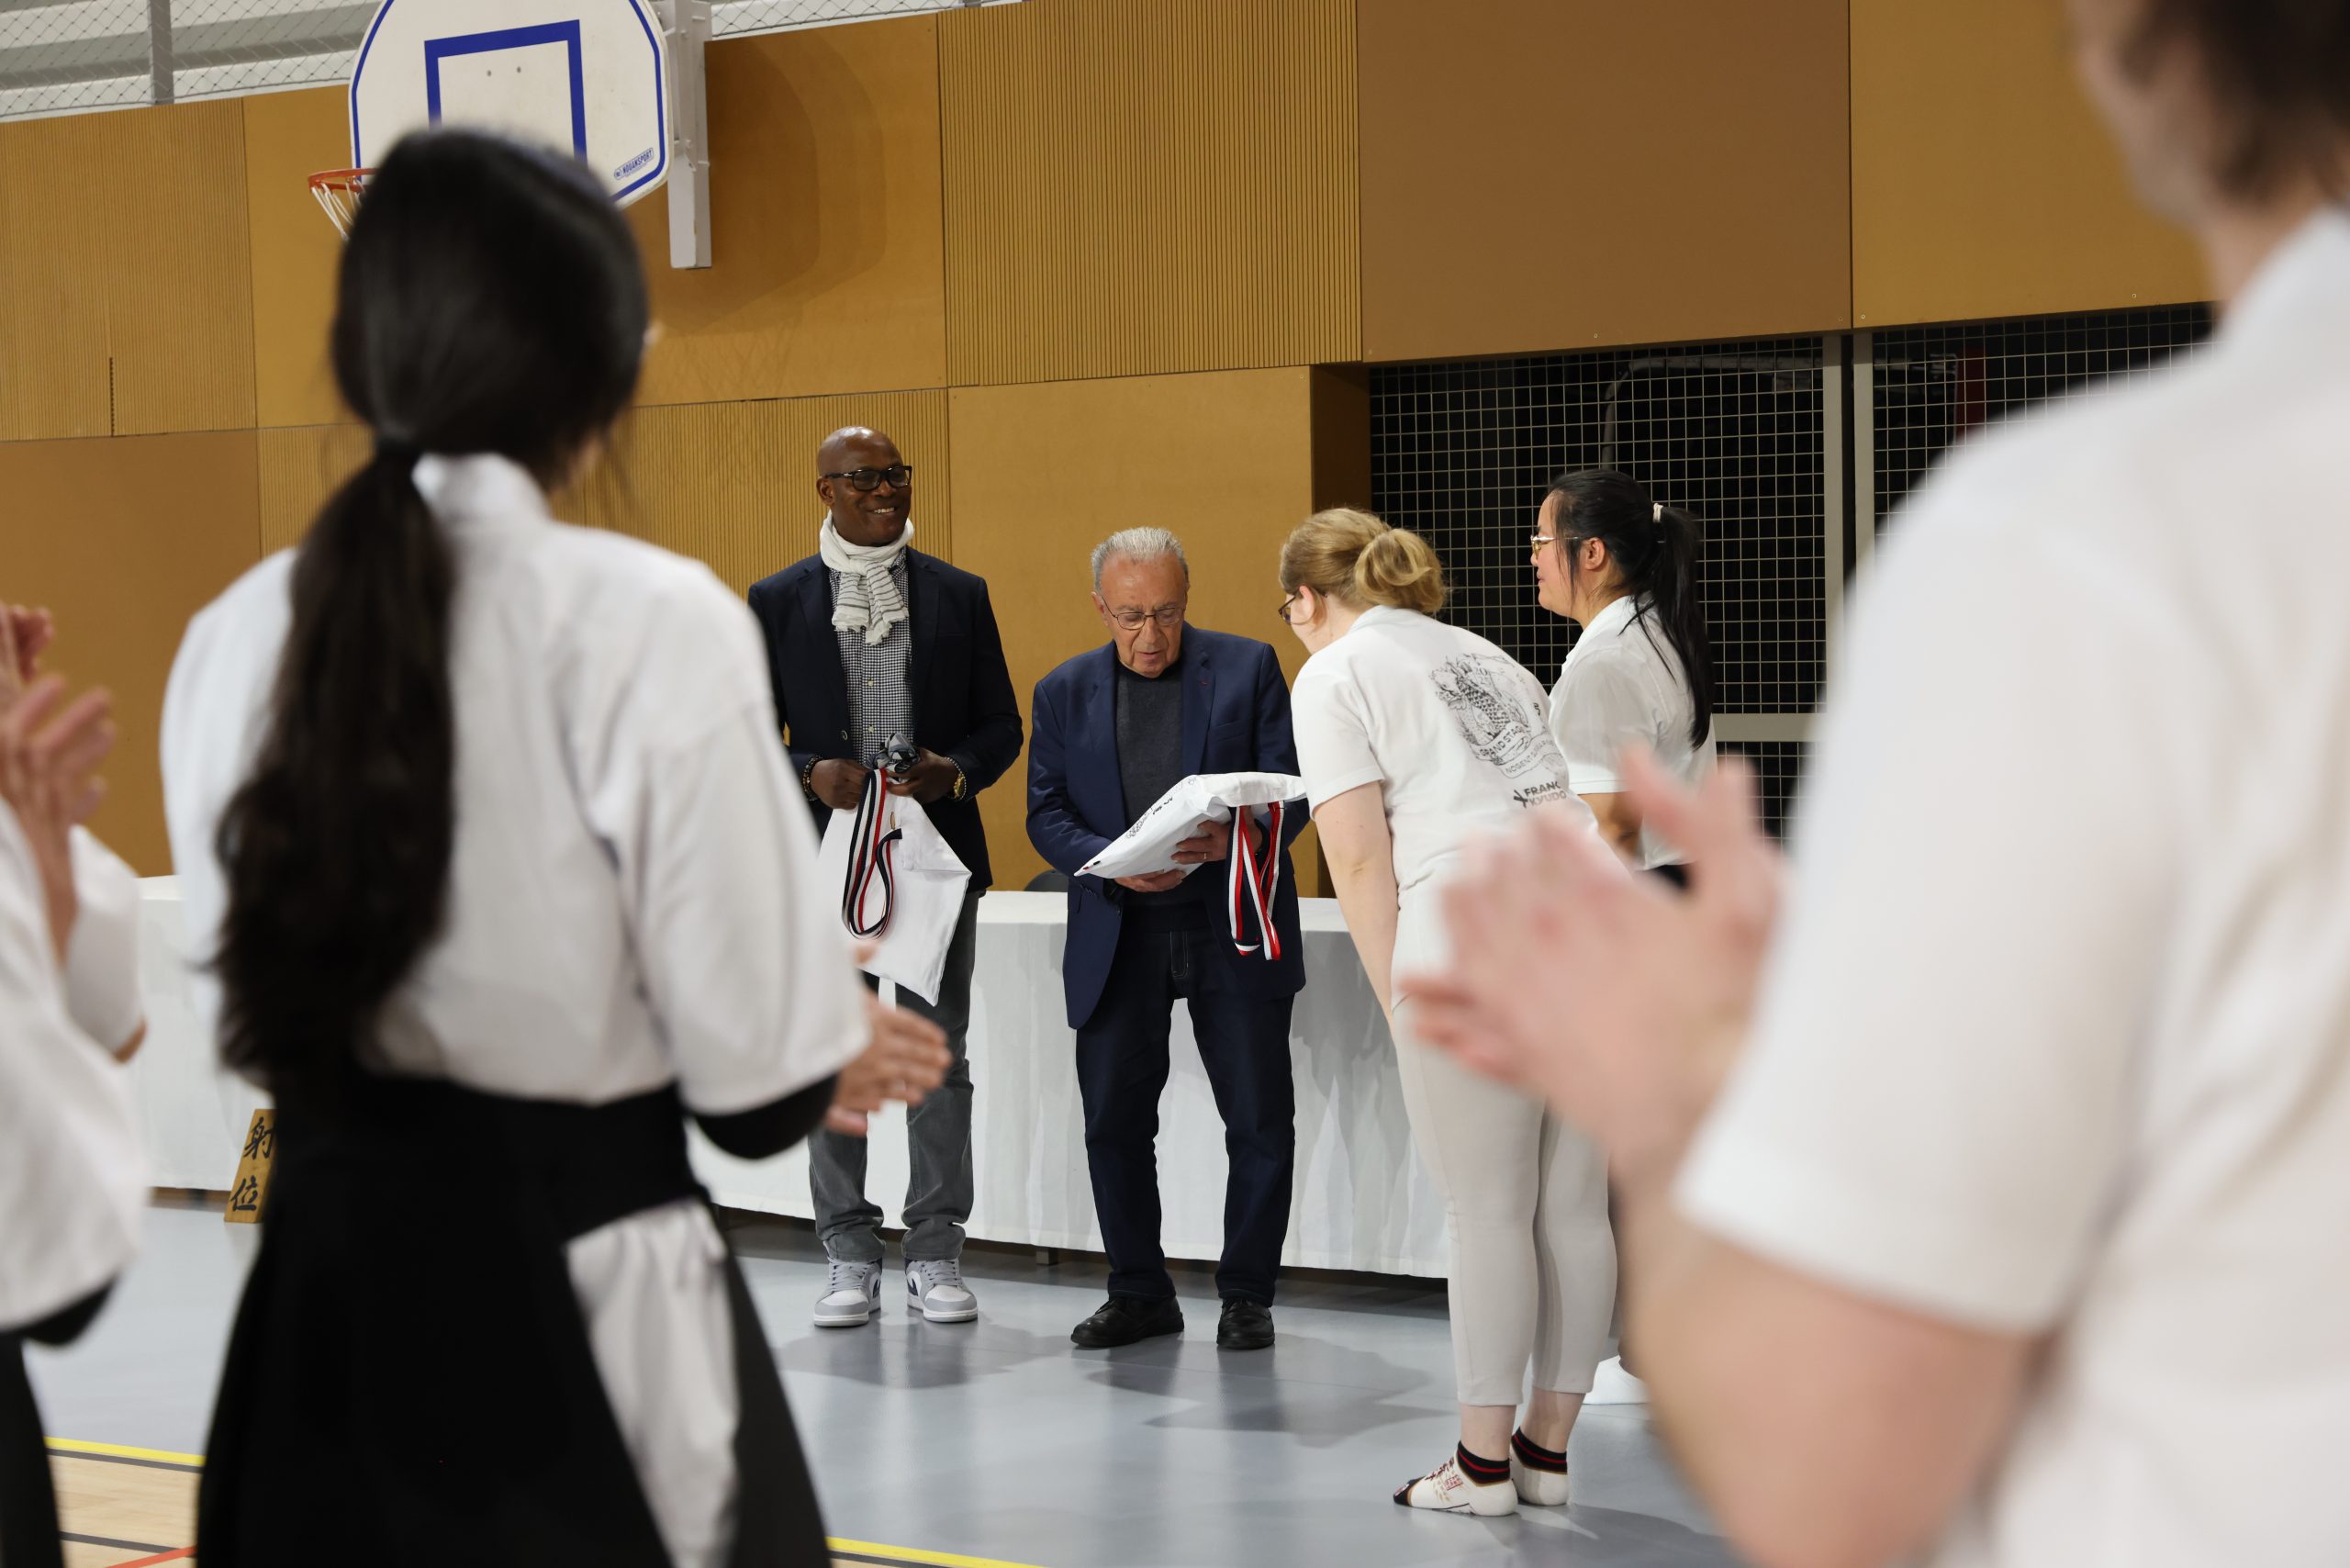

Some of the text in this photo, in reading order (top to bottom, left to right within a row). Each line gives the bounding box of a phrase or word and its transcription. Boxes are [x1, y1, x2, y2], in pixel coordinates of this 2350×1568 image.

[1480, 741, 1505, 757] GRAND
[1524, 781, 1561, 797] FRANC
[1528, 790, 1566, 806] KYUDO
